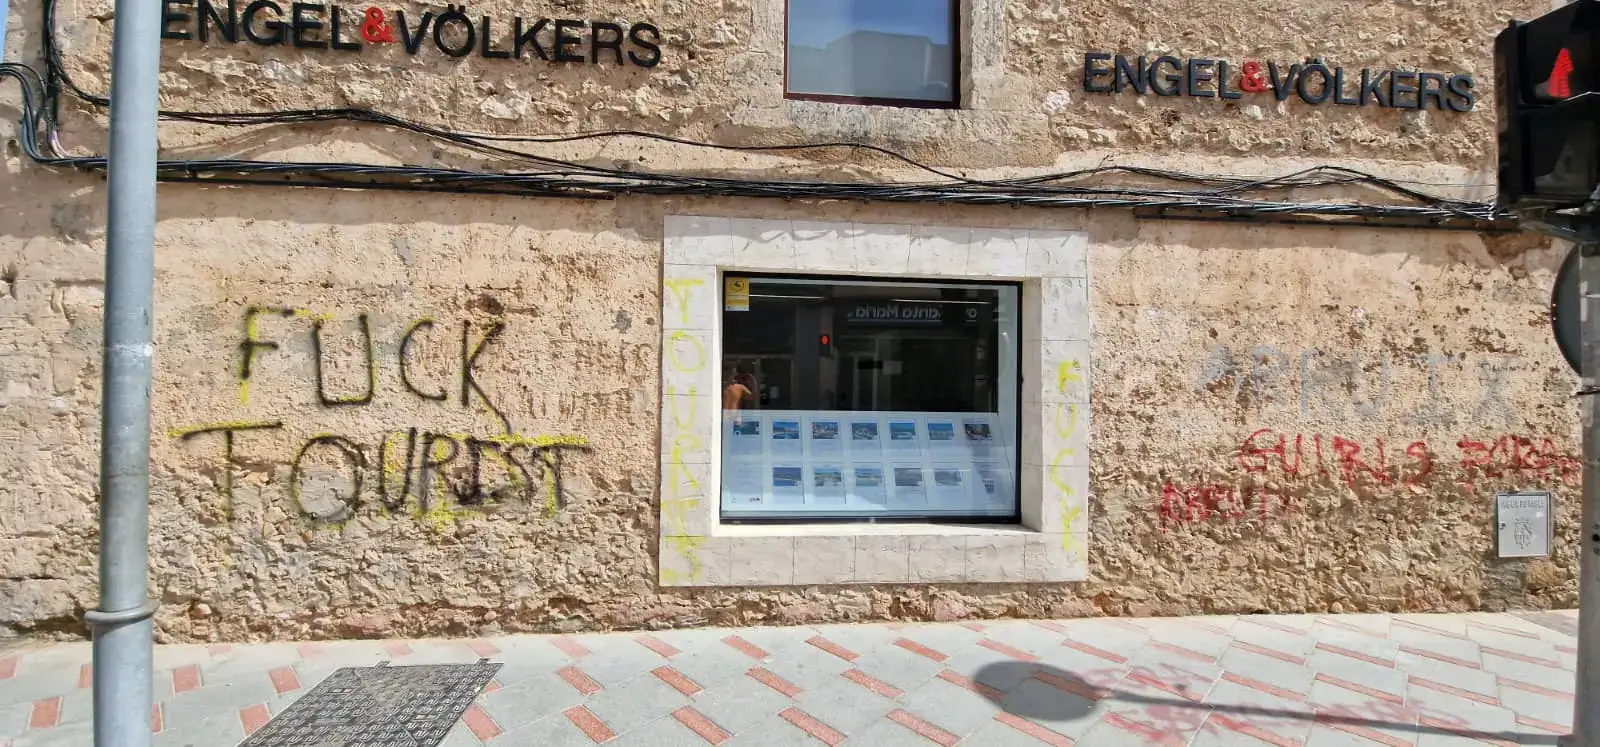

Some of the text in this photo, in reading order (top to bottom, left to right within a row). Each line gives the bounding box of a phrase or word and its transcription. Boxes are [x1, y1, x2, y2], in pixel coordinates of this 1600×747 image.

[1084, 53, 1475, 112] ENGEL&VÖLKERS
[232, 305, 508, 434] FUCK
[167, 421, 592, 529] TOURIST
[1052, 361, 1086, 562] FUCK
[1239, 430, 1434, 487] GUIRIS
